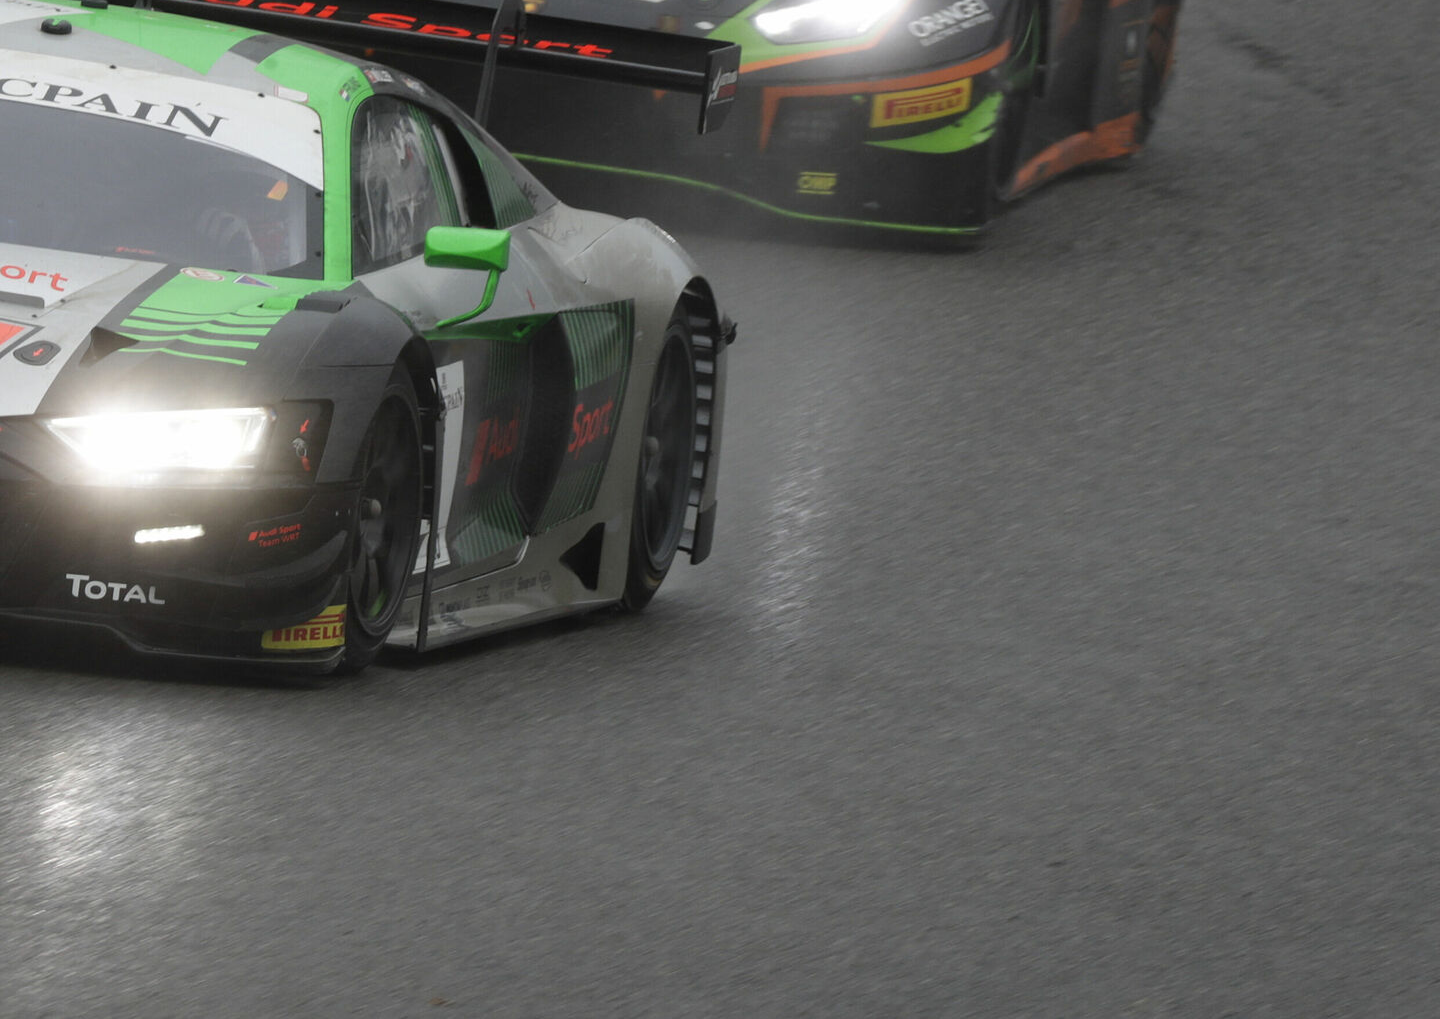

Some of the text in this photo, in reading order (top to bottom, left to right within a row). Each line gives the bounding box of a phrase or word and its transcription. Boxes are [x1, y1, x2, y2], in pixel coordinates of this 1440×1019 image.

[360, 12, 615, 59] Sport
[884, 86, 965, 121] PIRELLI
[568, 396, 614, 461] Sport
[258, 532, 301, 548] Team WRT
[259, 524, 301, 537] Audi Sport
[65, 573, 166, 606] TOTAL
